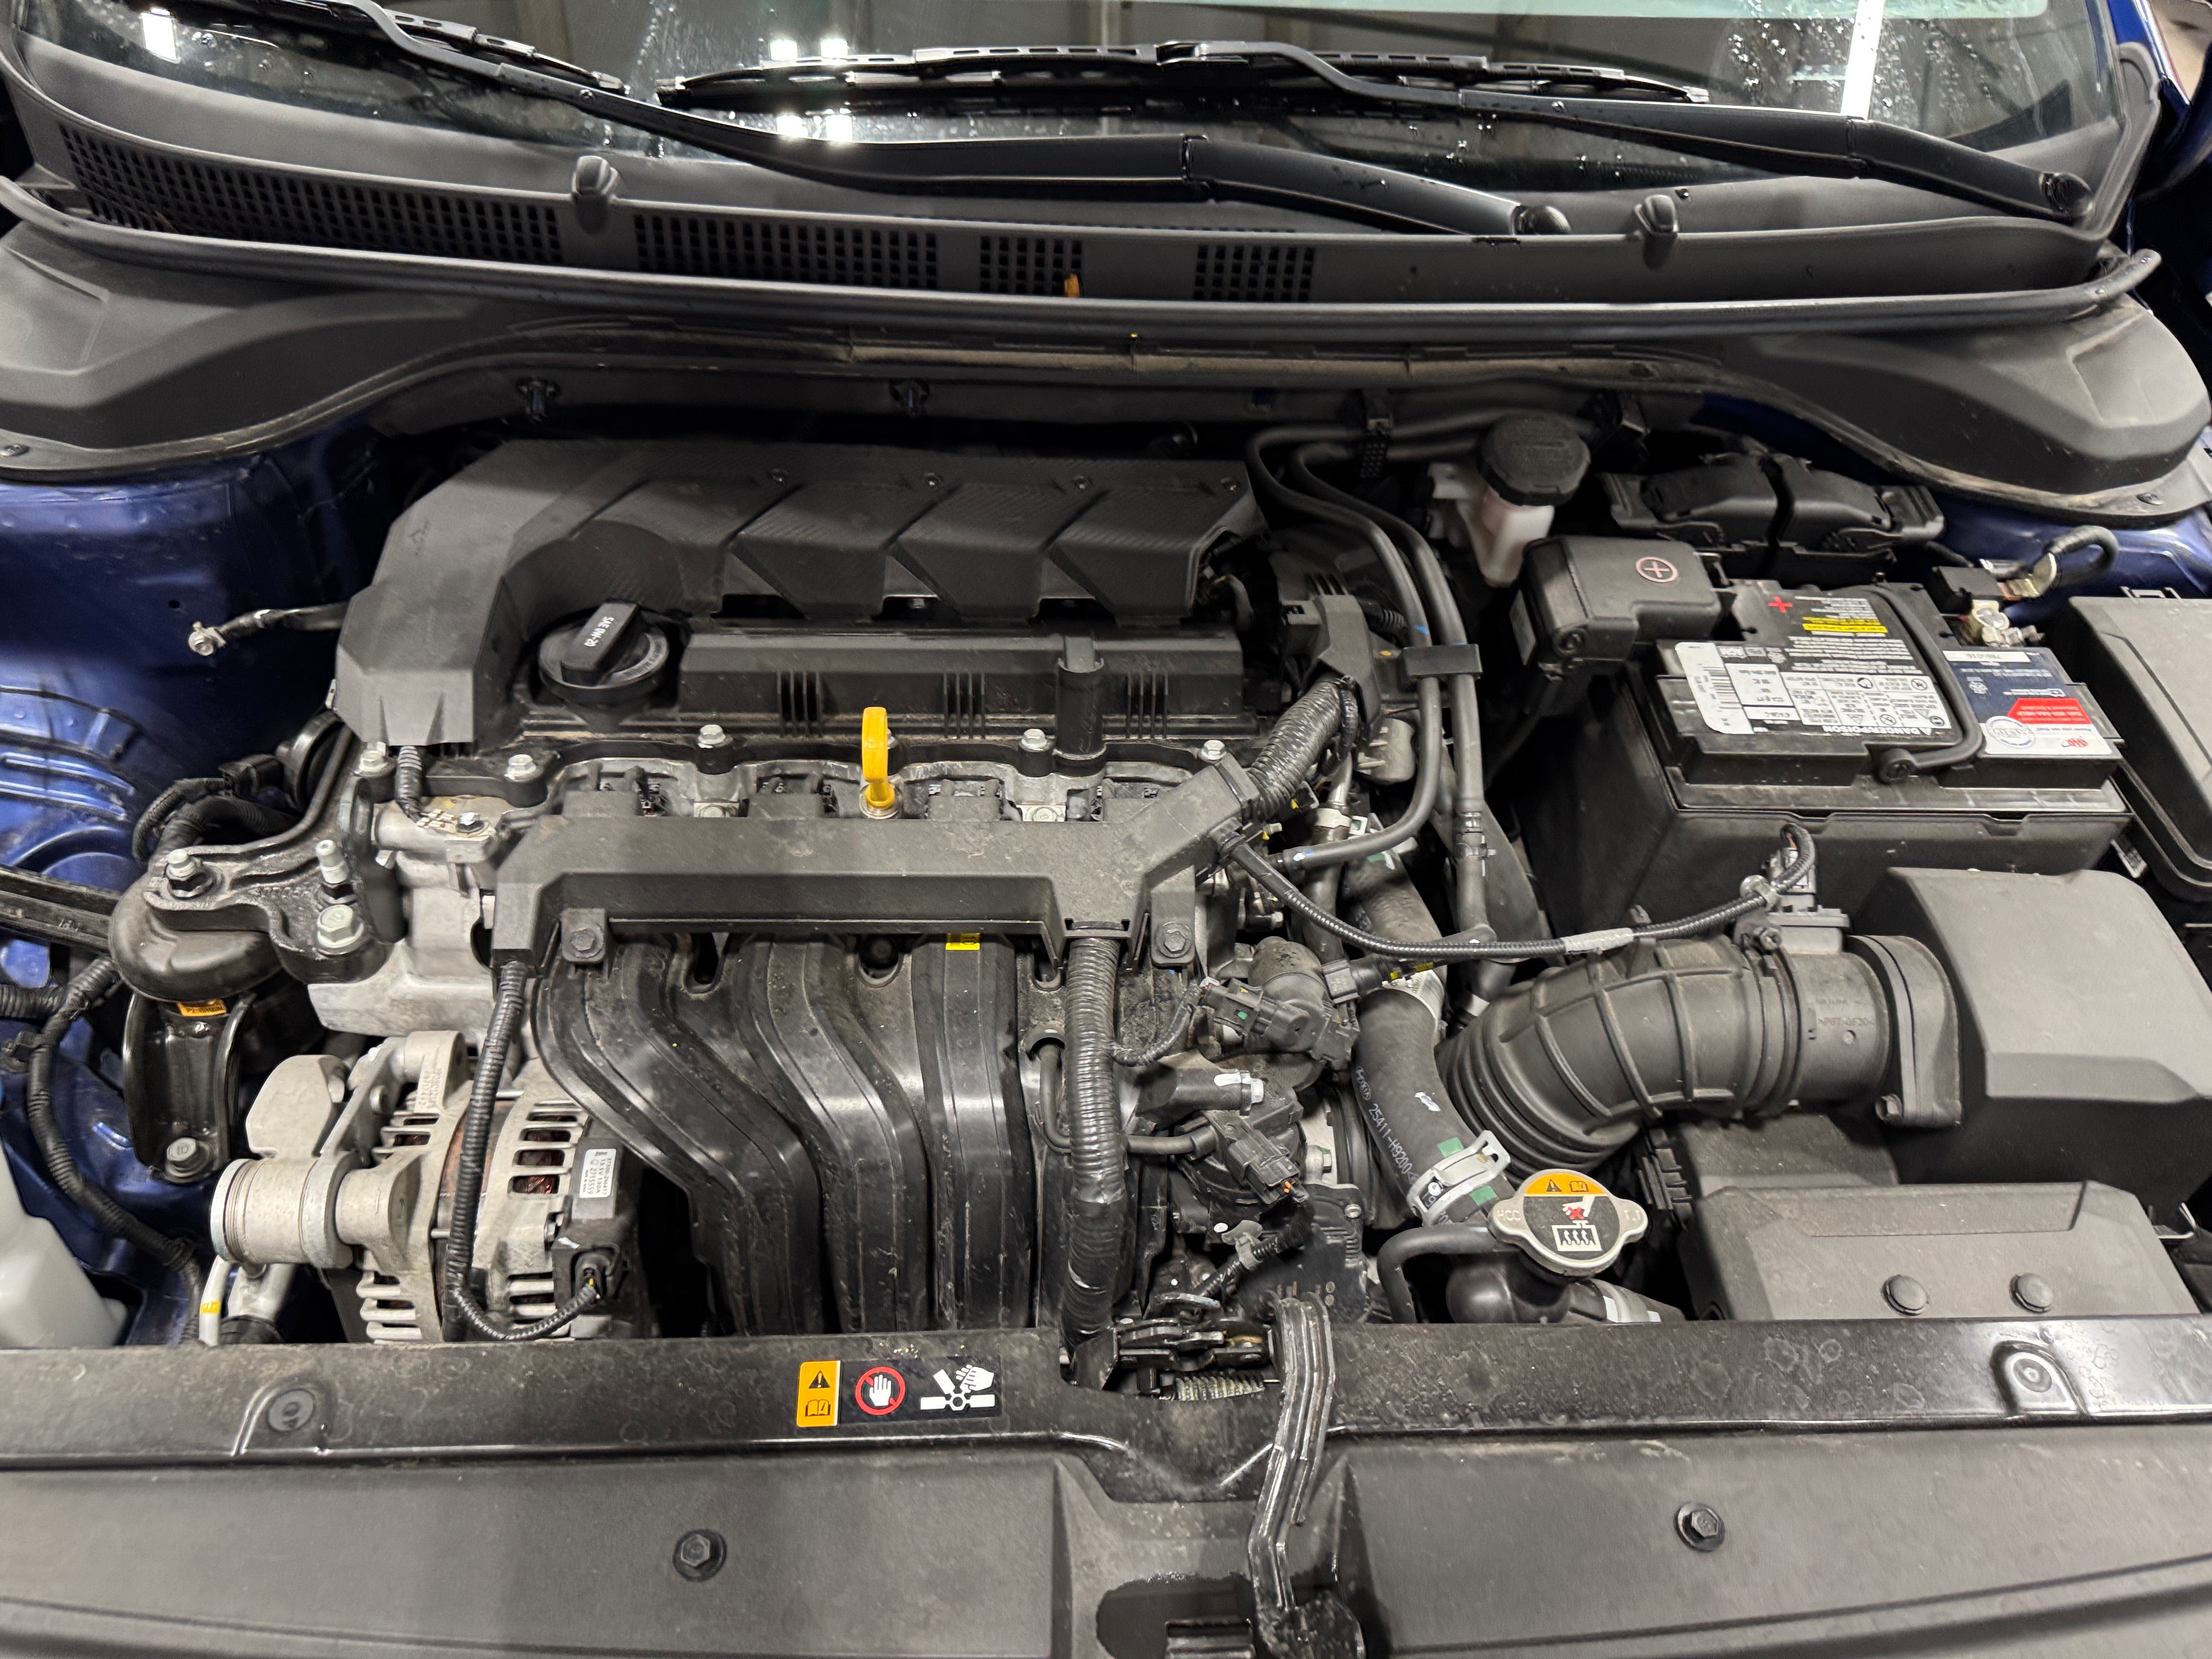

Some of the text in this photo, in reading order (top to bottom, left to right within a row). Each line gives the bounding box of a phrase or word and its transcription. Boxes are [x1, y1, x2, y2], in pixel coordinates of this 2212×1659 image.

[583, 616, 614, 647] SAE 0W-20
[1368, 1102, 1412, 1175] 25411-H9200
[1497, 1210, 1521, 1221] HCC
